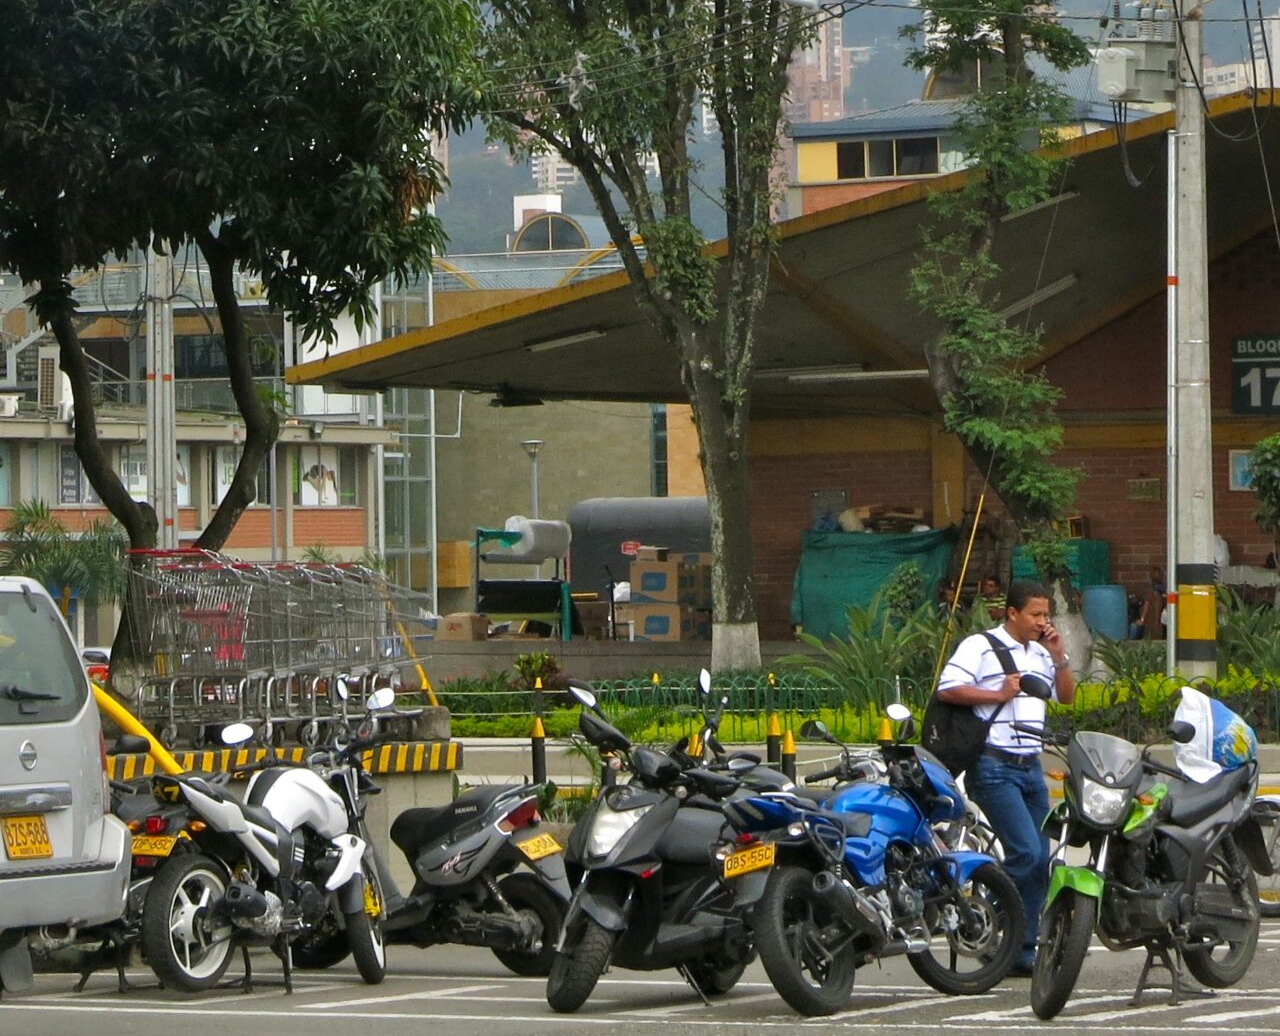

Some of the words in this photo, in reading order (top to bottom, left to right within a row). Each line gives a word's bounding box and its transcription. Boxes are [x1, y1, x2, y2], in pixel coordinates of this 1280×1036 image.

[1237, 339, 1280, 354] BLOQ
[1240, 367, 1280, 407] 17
[454, 805, 482, 815] YAMAHA
